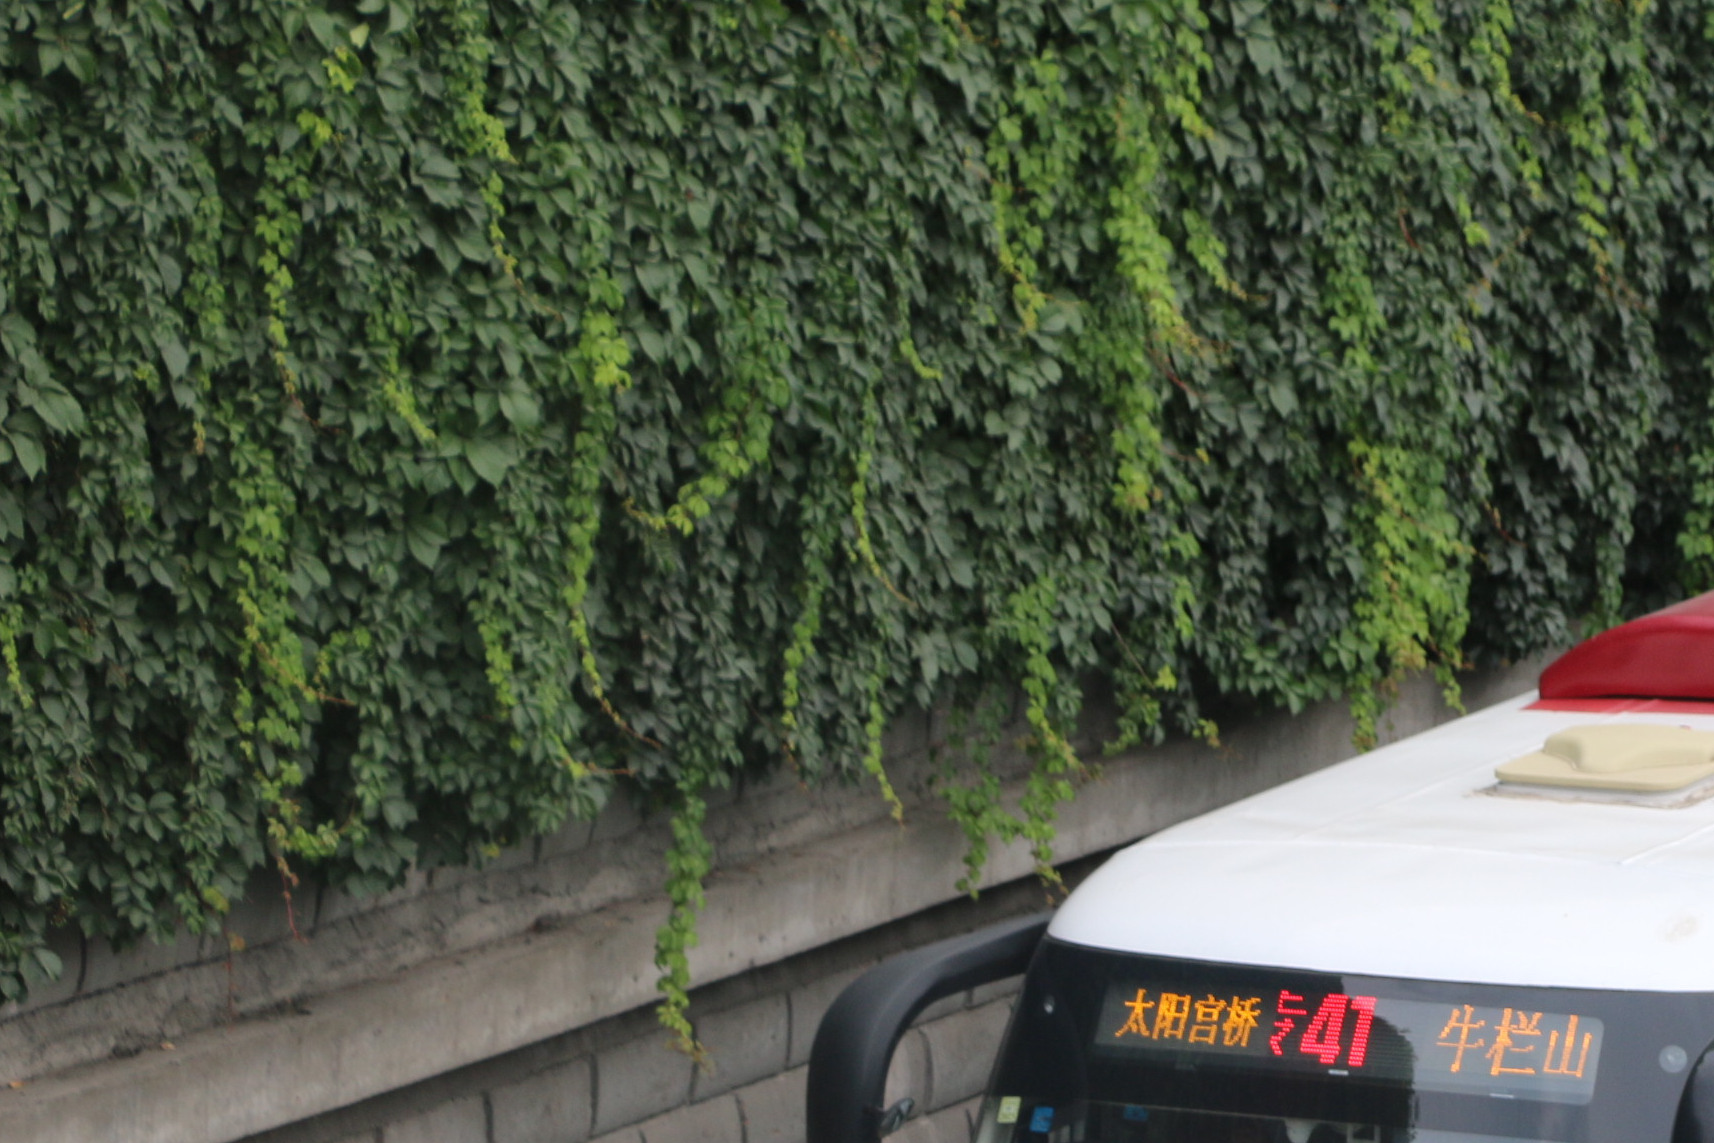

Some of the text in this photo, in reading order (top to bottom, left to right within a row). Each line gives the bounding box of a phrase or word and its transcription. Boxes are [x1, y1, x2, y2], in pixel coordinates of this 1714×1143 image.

[1114, 987, 1262, 1048] 太阳宫桥
[1436, 1004, 1594, 1079] 牛栏山
